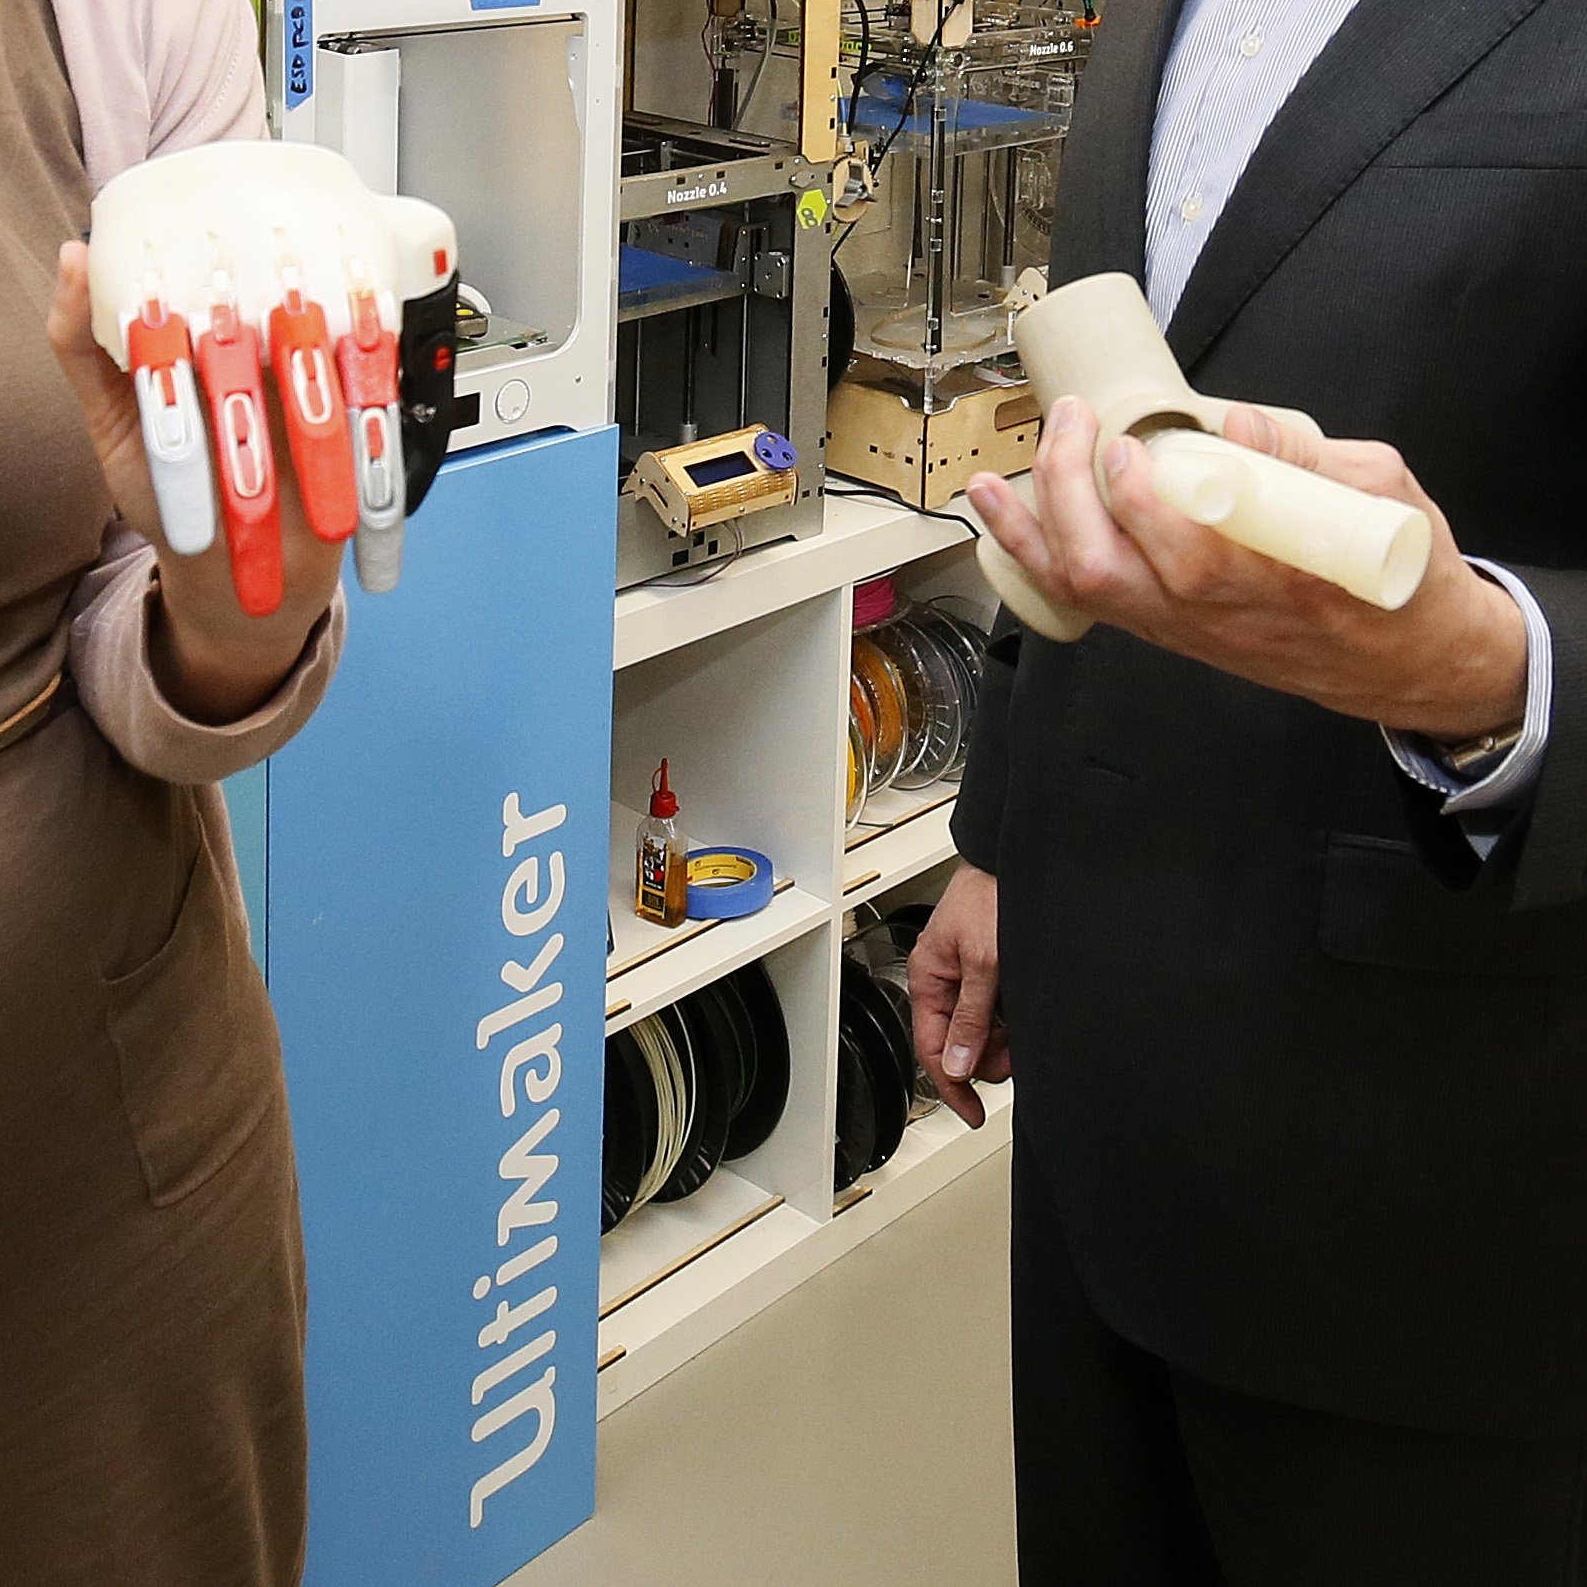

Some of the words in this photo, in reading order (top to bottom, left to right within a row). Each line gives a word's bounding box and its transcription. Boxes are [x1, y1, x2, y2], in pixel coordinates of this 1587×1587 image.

[1029, 42, 1058, 56] Nozzle
[1060, 40, 1074, 54] 0.6
[666, 185, 706, 204] Nozzle
[708, 181, 727, 197] 0.4
[470, 792, 567, 1528] Ultimaker
